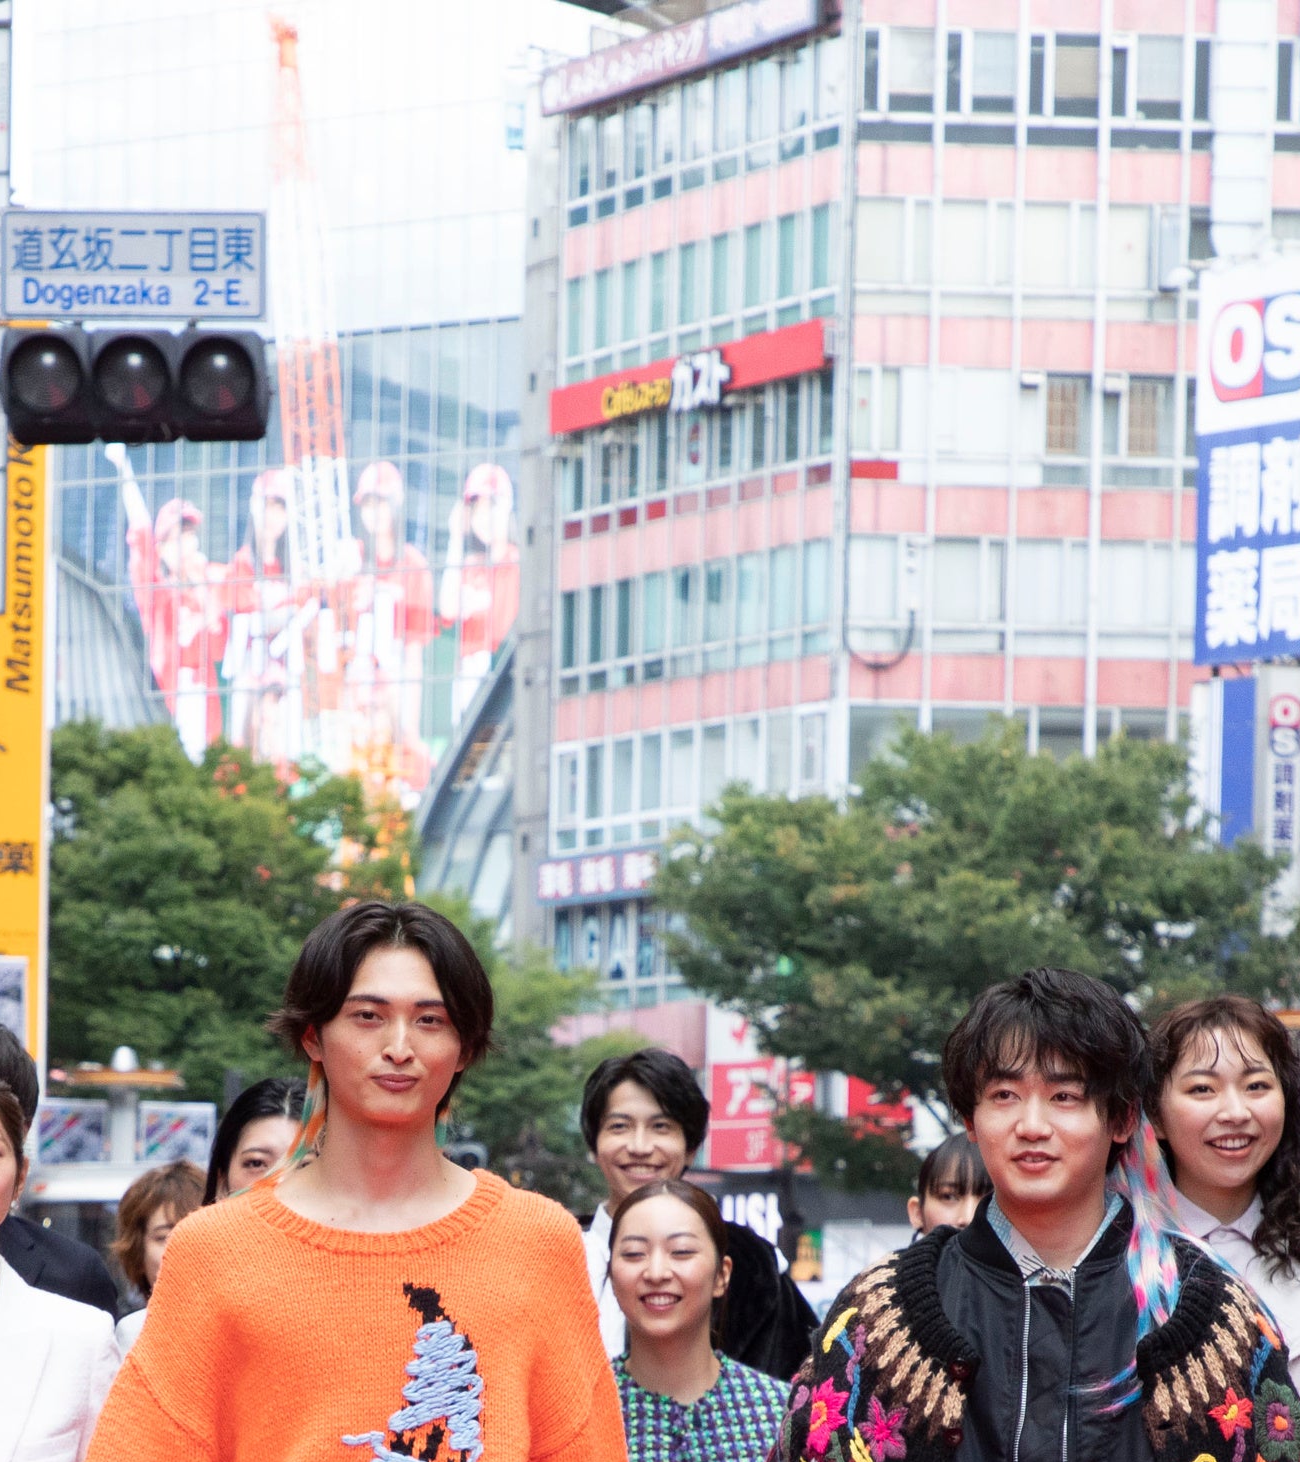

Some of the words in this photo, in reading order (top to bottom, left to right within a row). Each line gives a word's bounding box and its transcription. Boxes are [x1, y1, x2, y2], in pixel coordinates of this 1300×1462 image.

[12, 226, 255, 272] 道玄坂二丁目東
[22, 276, 172, 310] Dogenzaka
[4, 477, 33, 694] Matsumoto
